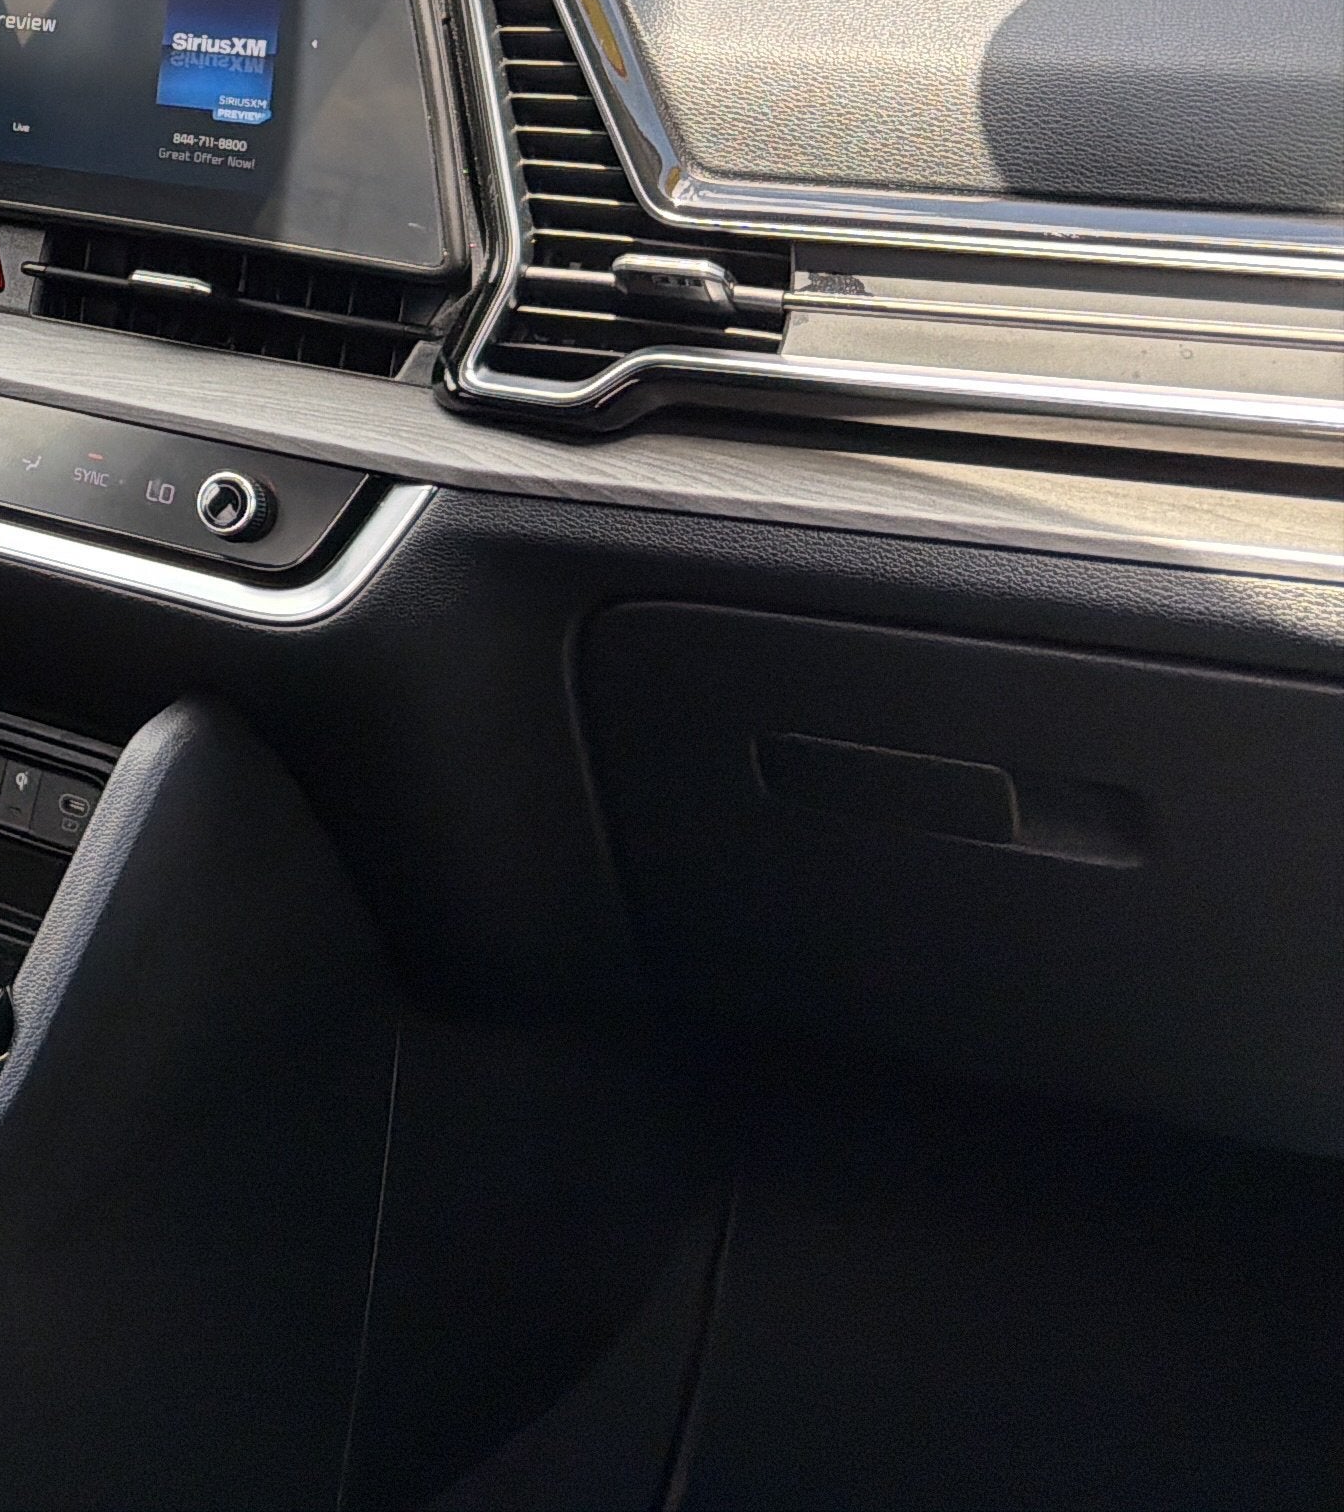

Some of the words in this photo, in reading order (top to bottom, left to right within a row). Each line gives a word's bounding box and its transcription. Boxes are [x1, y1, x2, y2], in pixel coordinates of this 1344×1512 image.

[171, 32, 268, 58] SiriusXM
[218, 95, 268, 109] SIRIUSXM
[158, 147, 190, 162] Great
[193, 150, 225, 166] Offer
[227, 155, 256, 170] Now!
[73, 467, 109, 487] SYNC
[145, 479, 175, 505] LO
